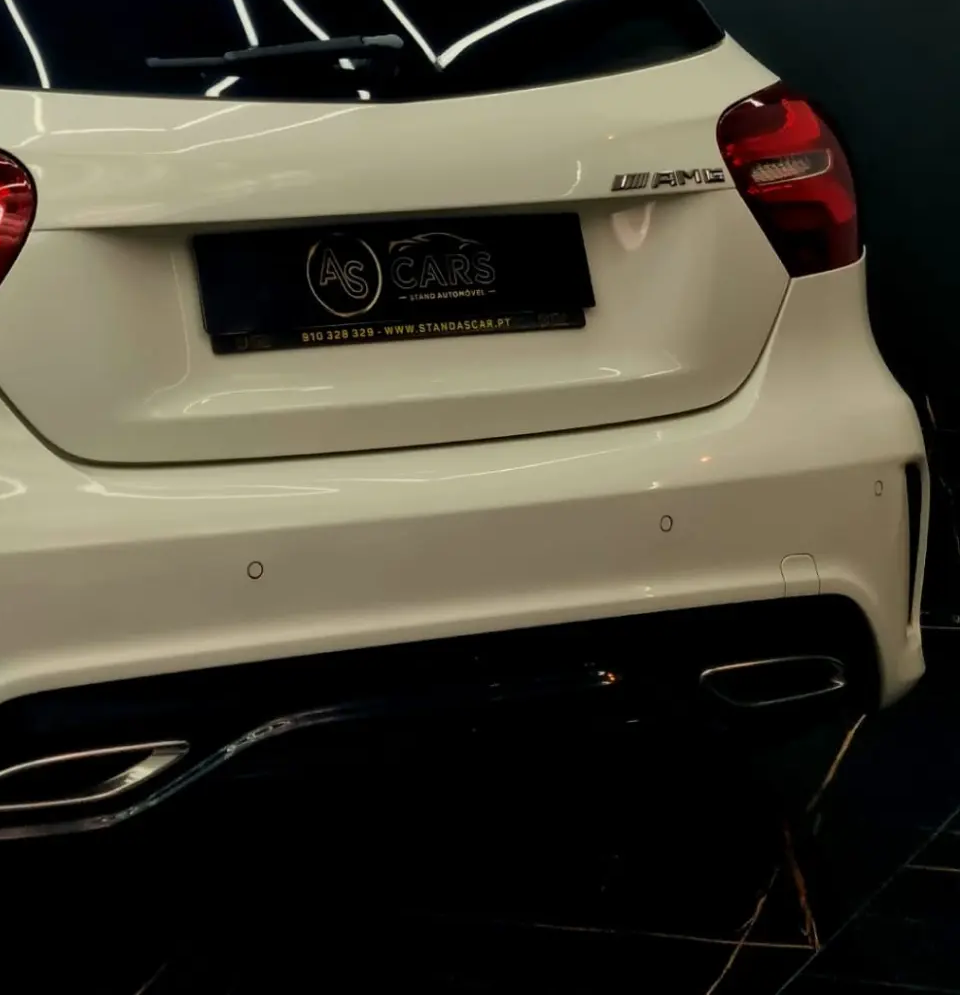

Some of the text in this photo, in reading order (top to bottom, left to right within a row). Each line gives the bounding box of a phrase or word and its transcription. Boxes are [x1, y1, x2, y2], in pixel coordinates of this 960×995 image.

[651, 168, 725, 189] AMG
[392, 252, 496, 290] CARS
[410, 292, 435, 301] STAND
[302, 332, 323, 342] 910
[326, 329, 349, 340] 328
[351, 327, 374, 338] 329
[384, 318, 512, 335] WWW.STANDASCAR.PT
